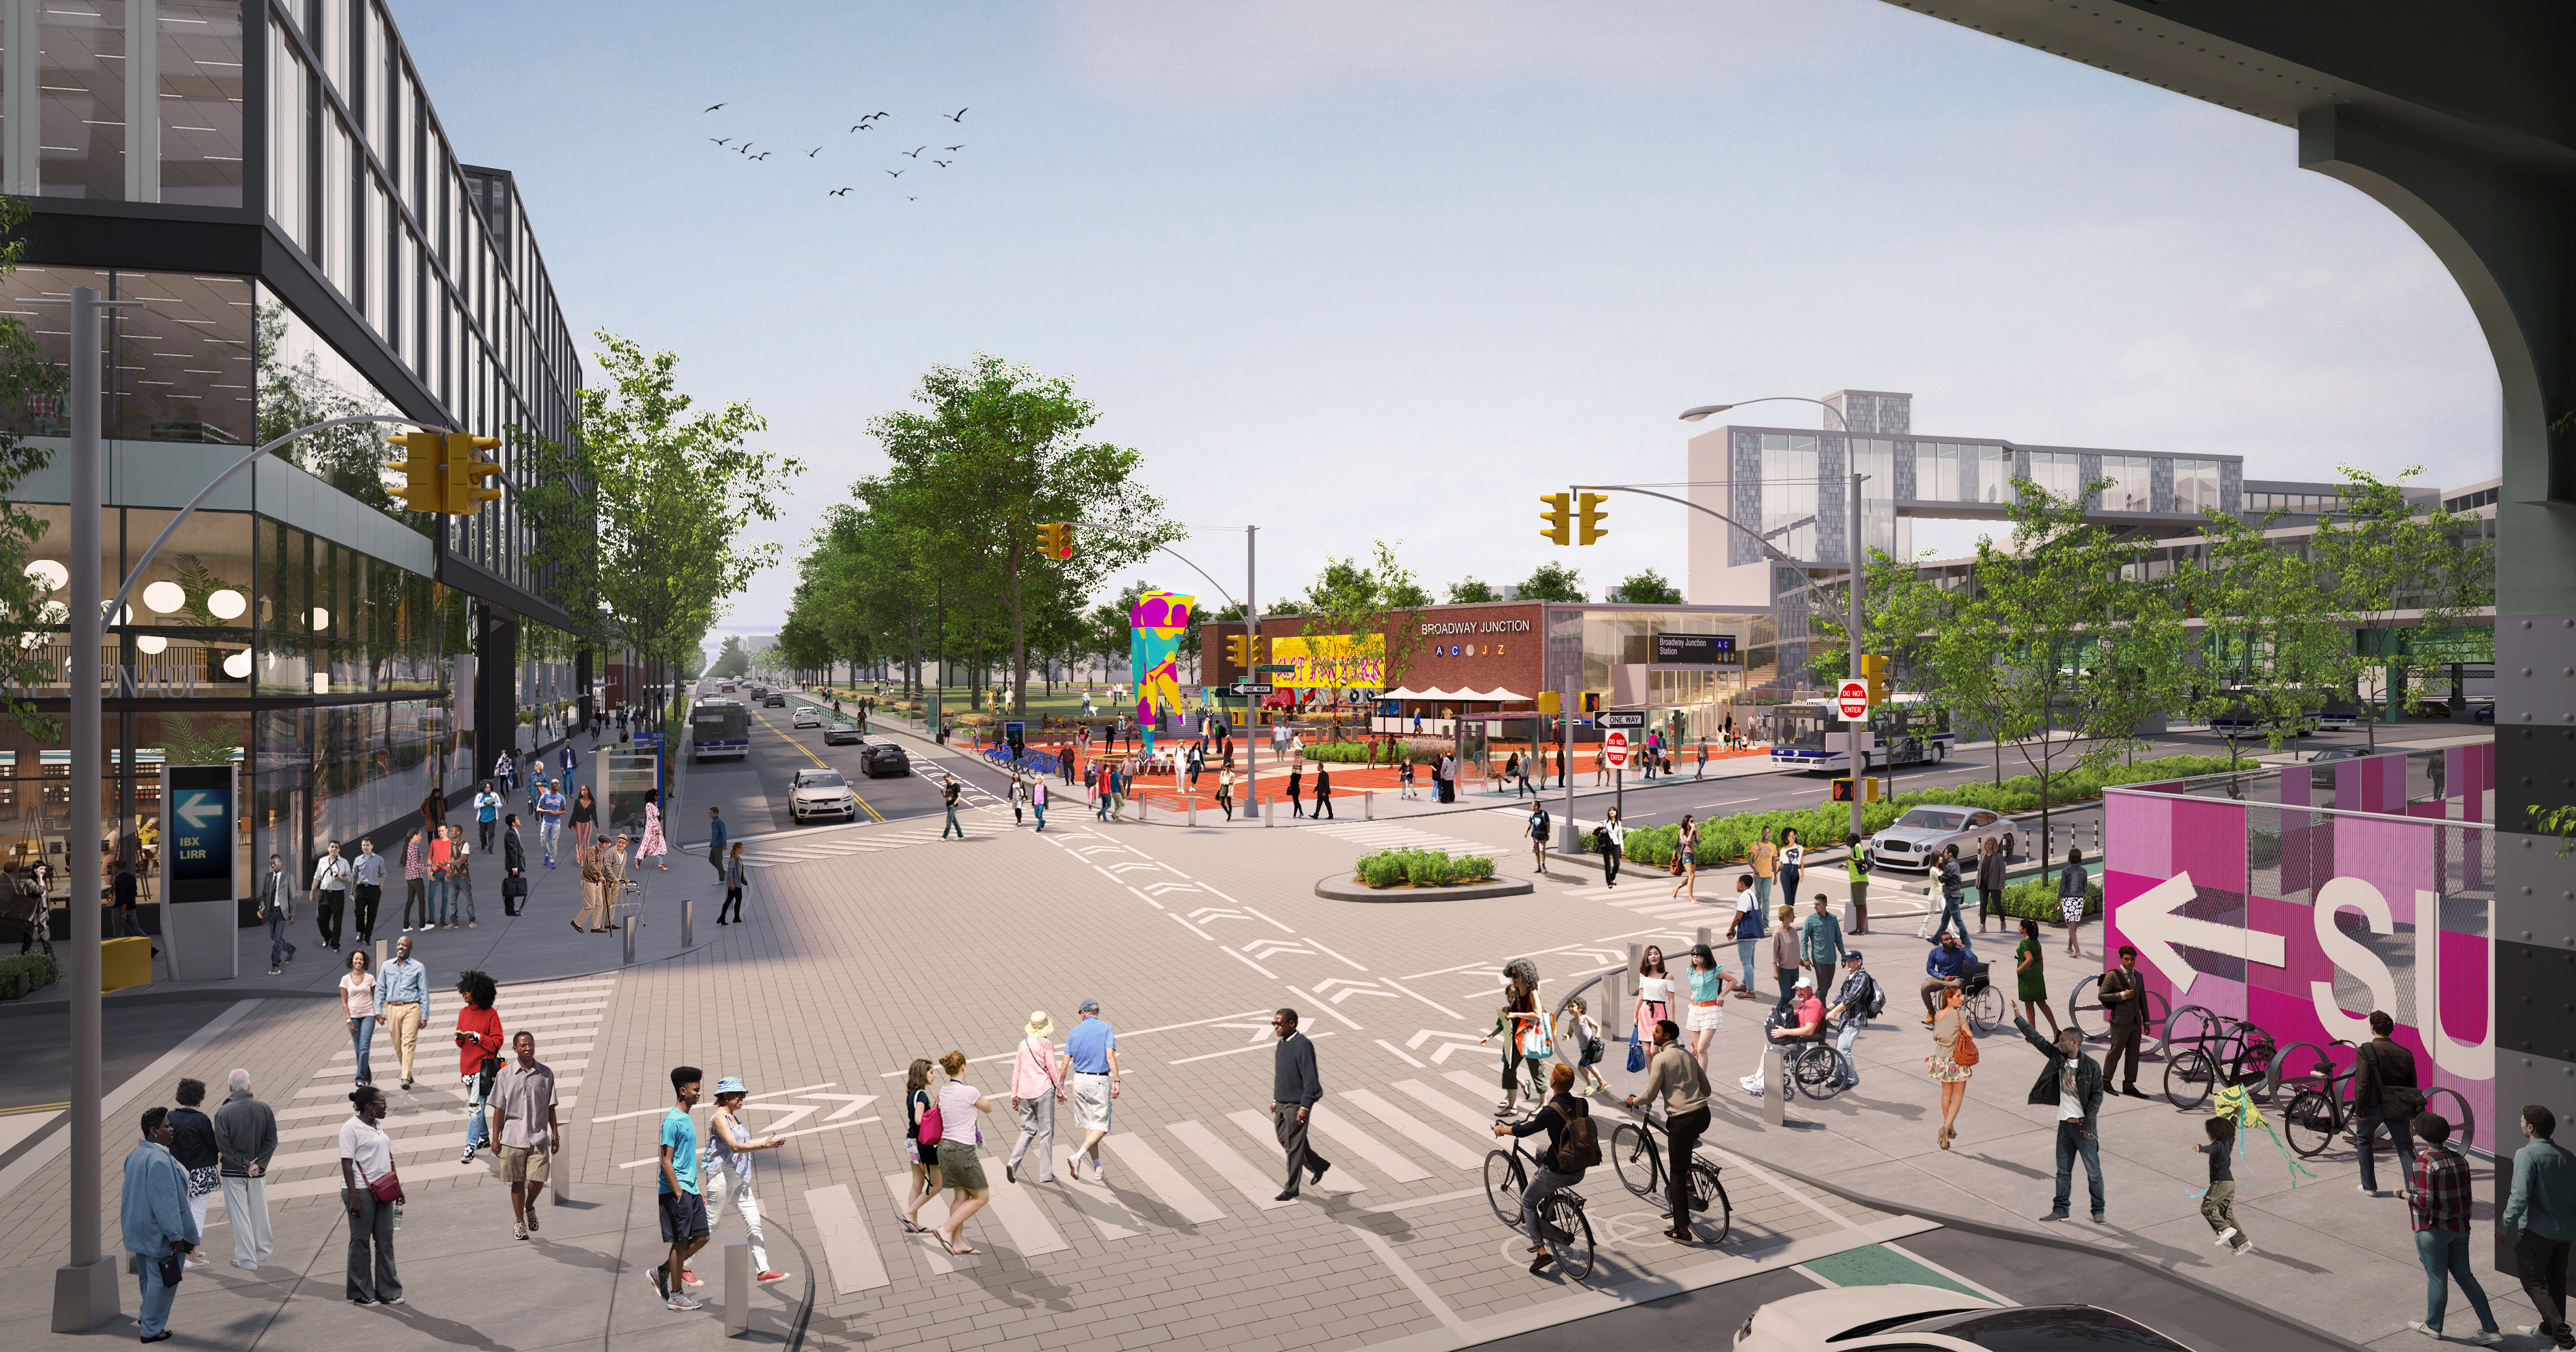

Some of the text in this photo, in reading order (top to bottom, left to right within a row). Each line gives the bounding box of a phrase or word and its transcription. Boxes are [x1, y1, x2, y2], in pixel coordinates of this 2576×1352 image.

[1422, 619, 1530, 634] BROADWAY JUNCTION
[1659, 638, 1706, 648] Broadway Junction
[1436, 644, 1504, 655] A C L J Z
[1659, 647, 1677, 655] Station
[180, 837, 200, 846] IBX
[180, 849, 206, 859] LIRR
